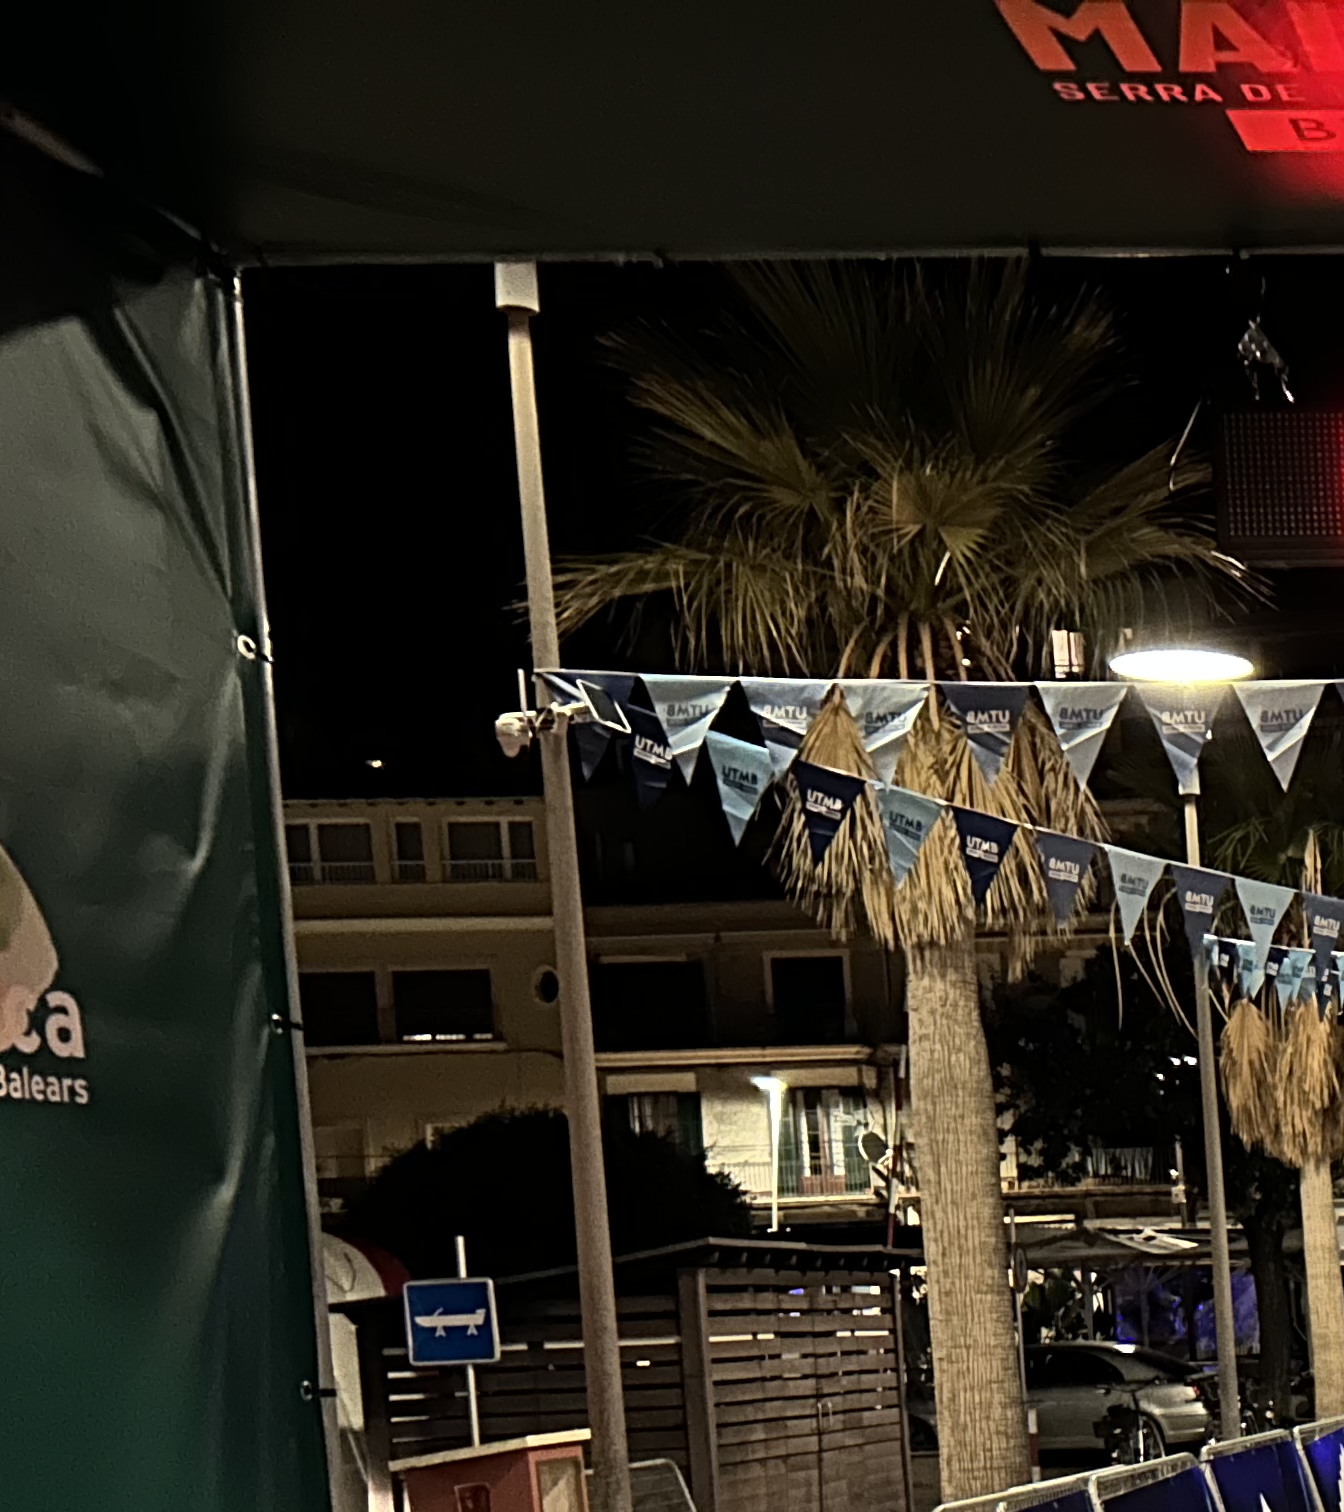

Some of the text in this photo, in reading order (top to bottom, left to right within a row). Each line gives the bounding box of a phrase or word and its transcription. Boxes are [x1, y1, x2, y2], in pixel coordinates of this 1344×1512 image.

[1052, 82, 1223, 104] SERRA
[1240, 82, 1306, 102] DE
[721, 765, 758, 785] UTMB
[806, 788, 843, 811] UTMB
[889, 811, 923, 832] UTMB
[966, 835, 999, 854] UTMB
